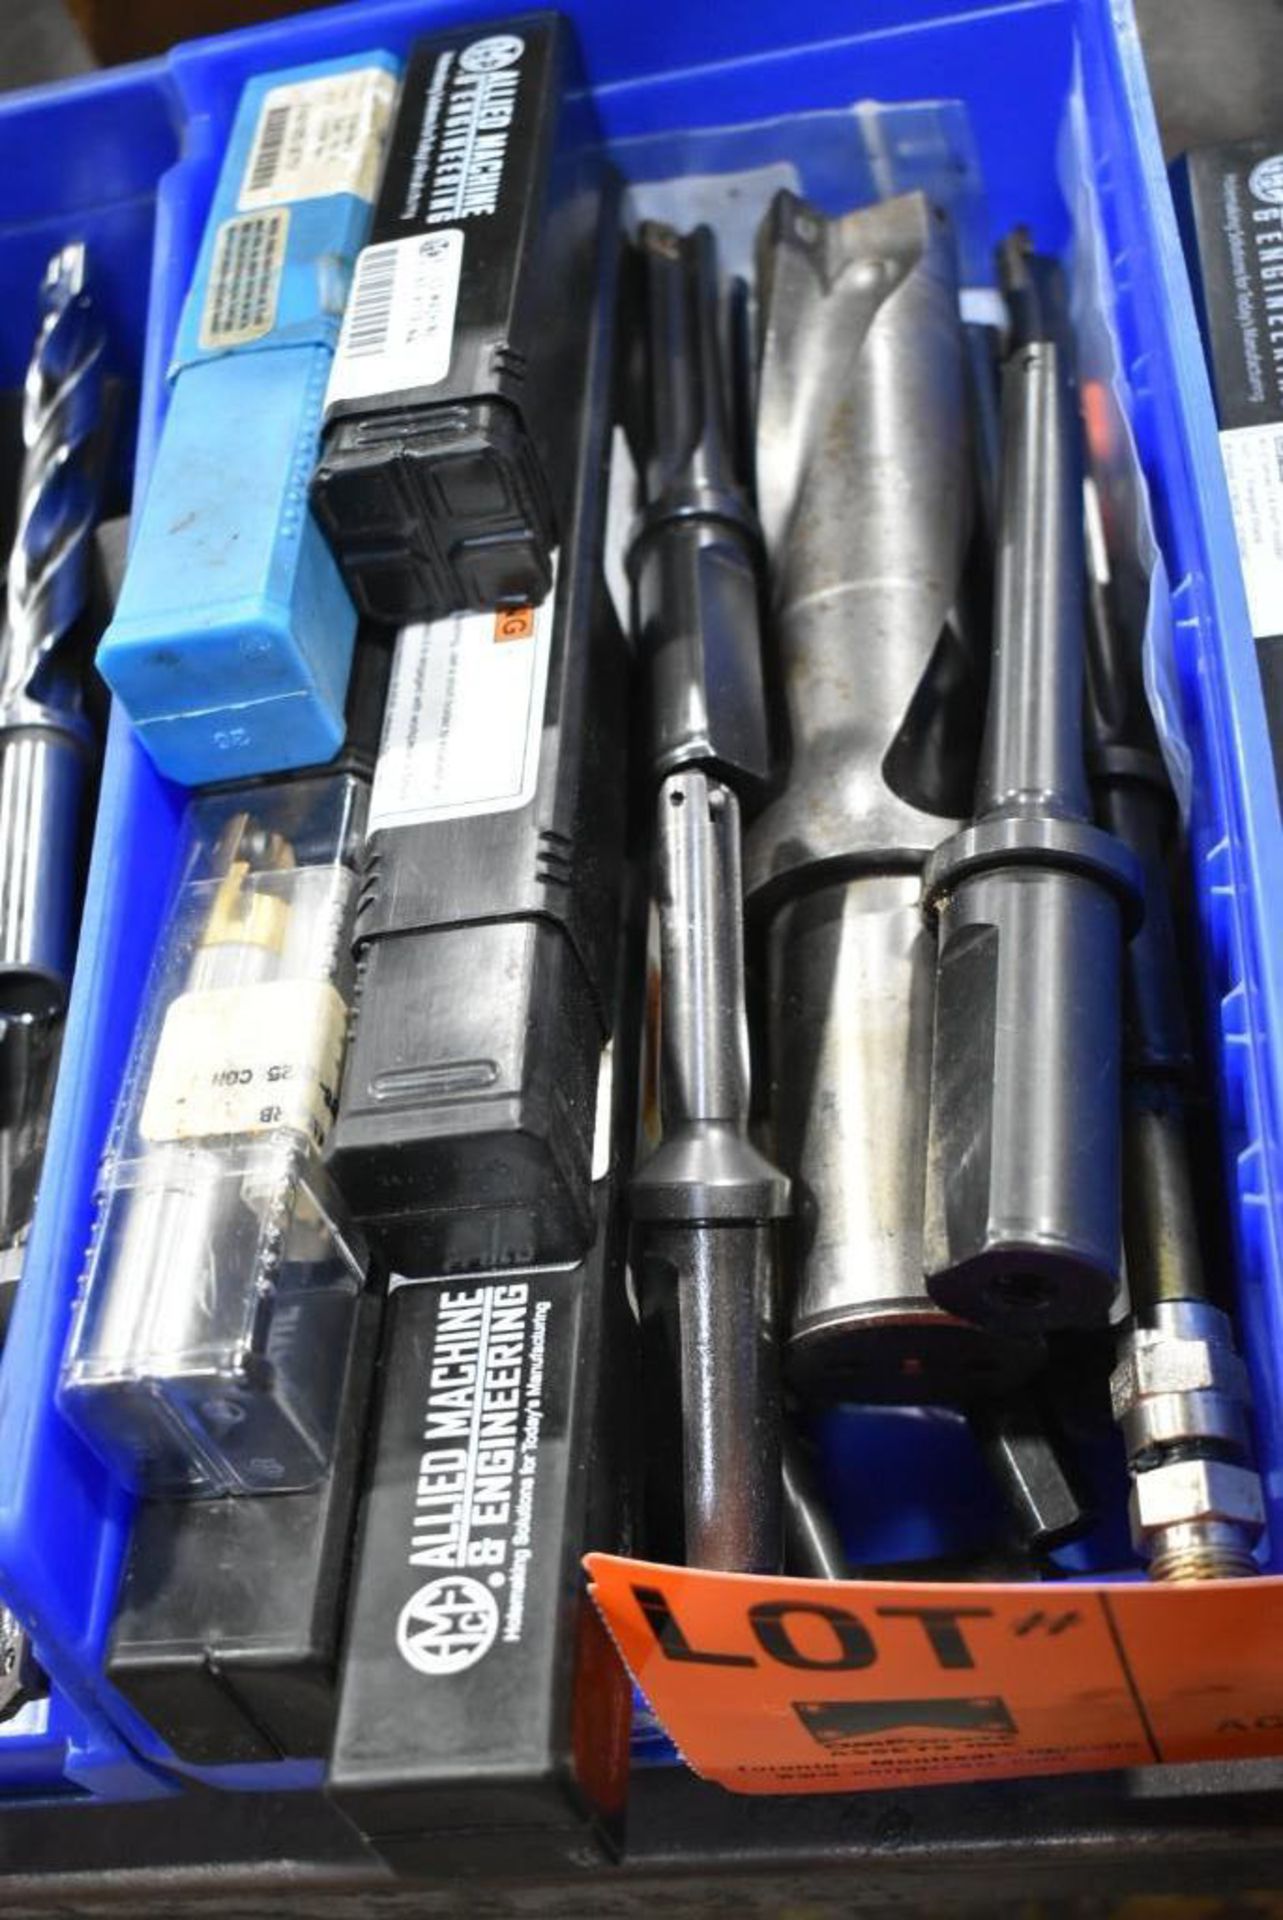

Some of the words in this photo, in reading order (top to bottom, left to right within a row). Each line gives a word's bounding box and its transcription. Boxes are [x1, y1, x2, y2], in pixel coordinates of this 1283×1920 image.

[477, 71, 520, 129] ALLIED
[460, 132, 509, 218] MACHINE
[424, 1287, 485, 1440] MACHINE
[525, 1301, 552, 1398] Manufacturing
[471, 1283, 529, 1527] ENGINEERING
[521, 1399, 544, 1454] Today's
[408, 1448, 467, 1568] ALLIED
[518, 1453, 537, 1475] for
[468, 1537, 507, 1567] &
[512, 1476, 536, 1546] Solutions
[503, 1549, 532, 1642] Holemaking
[629, 1583, 995, 1673] LOT
